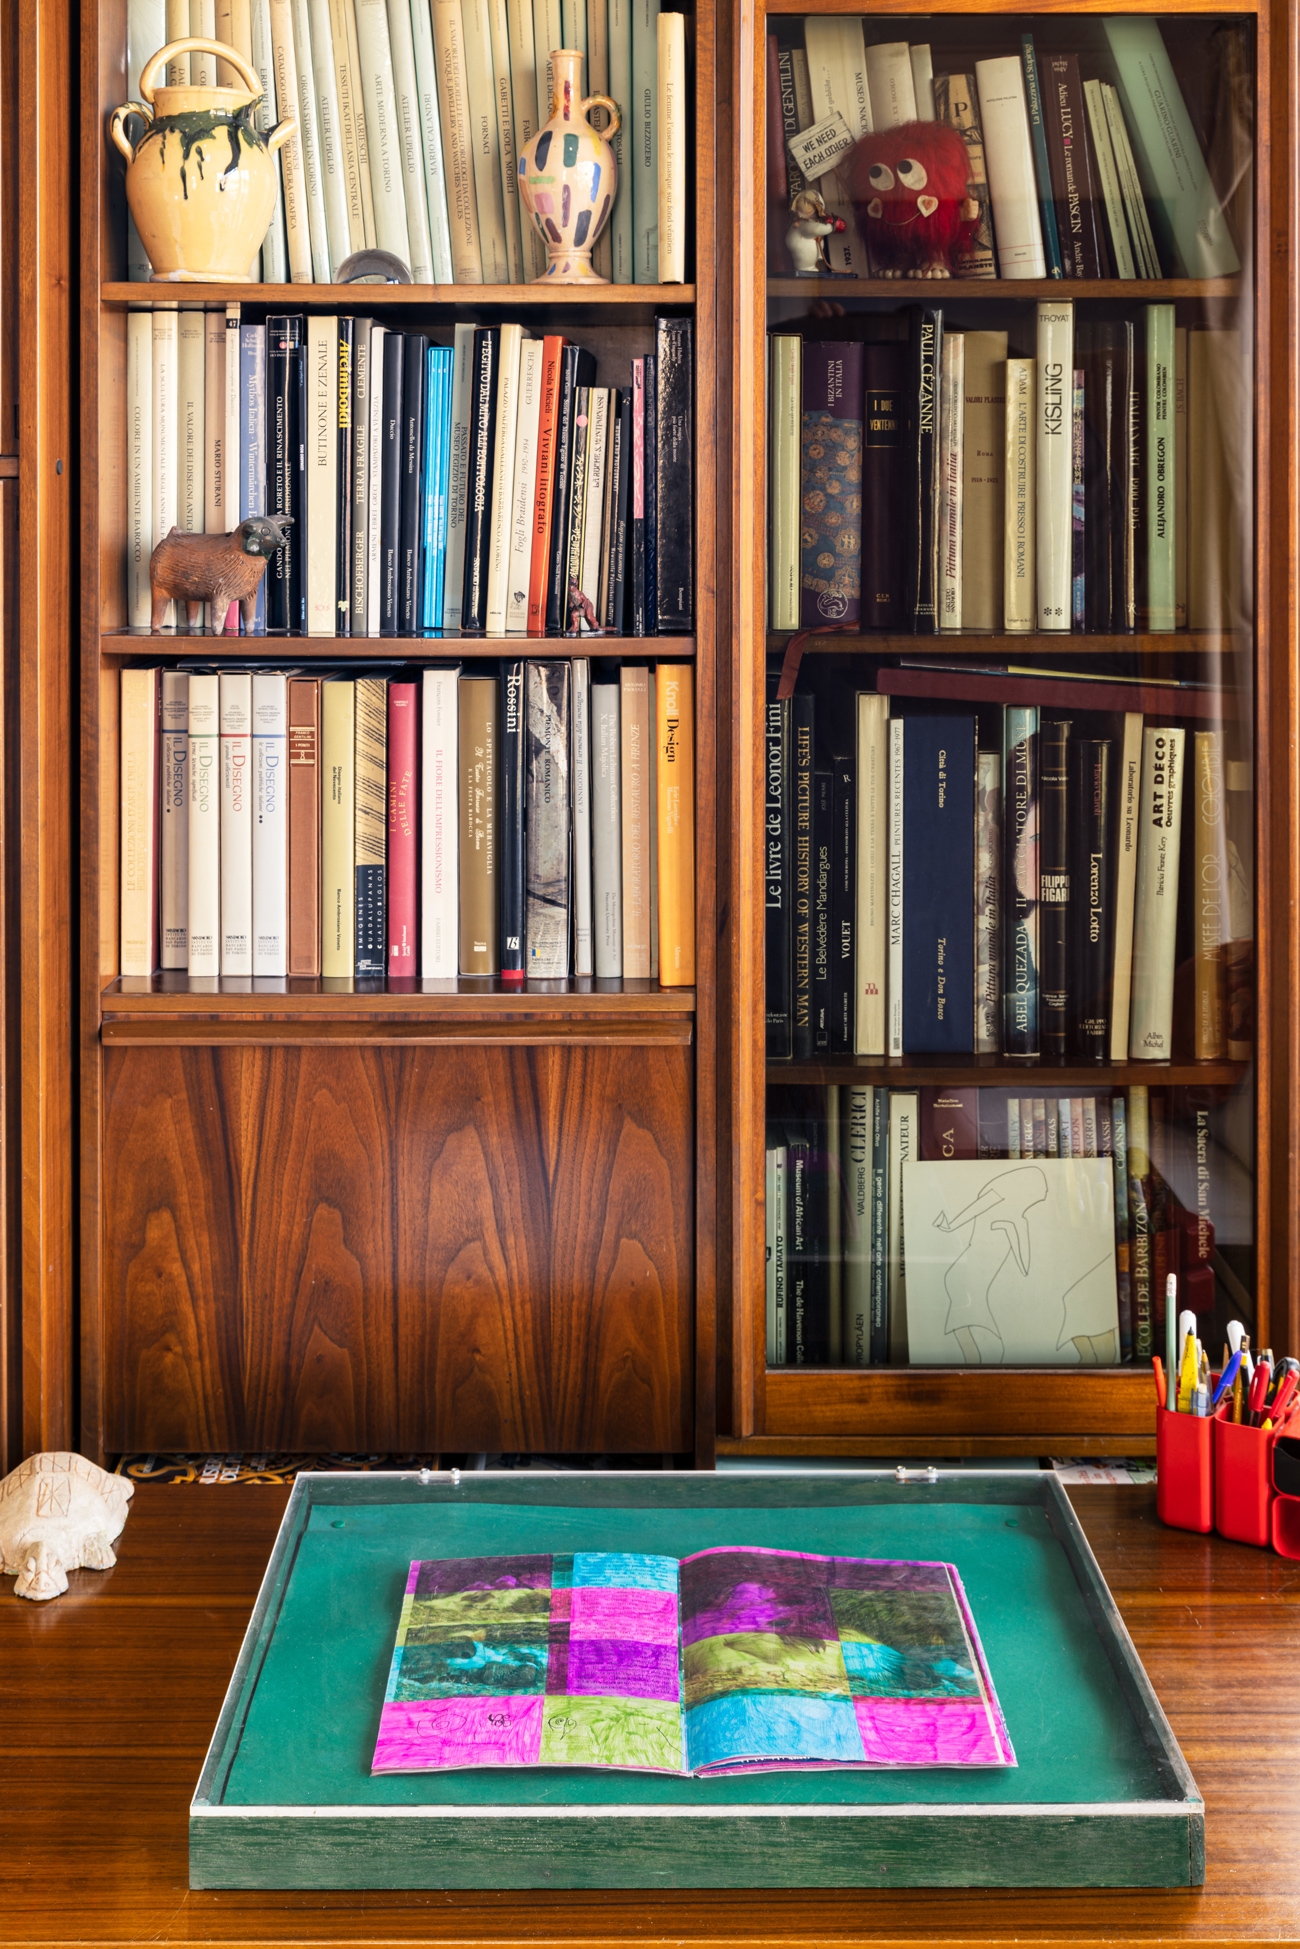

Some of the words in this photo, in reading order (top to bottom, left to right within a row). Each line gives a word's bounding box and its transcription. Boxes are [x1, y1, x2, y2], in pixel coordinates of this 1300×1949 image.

[1024, 44, 1035, 73] Stupinigi
[300, 75, 310, 110] ORGANI
[339, 64, 349, 99] TESSUTI
[374, 74, 385, 98] ARTE
[499, 78, 509, 118] GABETTI
[778, 51, 794, 115] GENTILINI
[854, 72, 865, 103] MUSEO
[1028, 82, 1039, 114] Palazzina
[1058, 83, 1068, 106] Adieu
[321, 95, 331, 134] ATELIER
[342, 102, 350, 122] IKAT
[377, 100, 388, 147] MODERNA
[402, 95, 412, 133] ATELIER
[424, 93, 436, 142] CALANDRI
[783, 117, 795, 130] DI
[1032, 116, 1040, 124] La
[1061, 108, 1073, 138] LUCY
[303, 113, 313, 150] STORICI
[344, 124, 355, 170] DELL'ASIA
[356, 113, 367, 164] MARIESCHI
[480, 116, 490, 155] FORNACI
[503, 128, 511, 156] ISOLA
[802, 138, 816, 153] WE
[816, 128, 836, 144] NEED
[307, 151, 314, 159] IN
[325, 136, 335, 174] UPIGLIO
[405, 135, 415, 173] UPIGLIO
[428, 143, 437, 176] MARIO
[803, 152, 825, 169] EACH
[825, 137, 850, 159] OTHER
[1064, 146, 1073, 156] Le
[307, 162, 317, 196] TORINO
[382, 157, 392, 192] TORINO
[505, 160, 514, 193] MOBILI
[348, 172, 359, 219] CENTRALE
[1069, 194, 1082, 232] PASCIN
[1074, 241, 1084, 263] André
[921, 324, 933, 359] PAUL
[318, 340, 328, 387] ZENALE
[357, 345, 366, 398] CLEMENTE
[481, 341, 492, 381] L'EGITTO
[545, 361, 555, 386] Nicola
[246, 375, 258, 405] Mythos
[339, 339, 351, 428] Arcimboldi
[480, 384, 489, 403] DAL
[544, 388, 553, 413] Micieli
[836, 388, 842, 397] IN
[921, 364, 935, 433] CÉZANNE
[1045, 363, 1062, 435] KISLING
[134, 406, 142, 442] COLORE
[249, 408, 257, 434] Italien
[318, 398, 328, 466] BUTINONE
[479, 404, 488, 427] MITO
[134, 445, 142, 455] IN
[134, 457, 142, 469] UN
[357, 425, 365, 467] FRAGILE
[540, 428, 552, 473] Viviani
[1157, 437, 1165, 481] OBREGON
[248, 442, 258, 508] Wintermärchen
[356, 470, 365, 504] TERRA
[475, 430, 487, 511] ALL'EGITTOLOGIA
[134, 472, 142, 517] AMBIENTE
[536, 478, 549, 534] litografo
[1157, 486, 1166, 538] ALEJANDRO
[134, 519, 142, 562] BAROCCO
[355, 531, 364, 613] BISCHOFBERGER
[506, 675, 521, 733] Rossini
[666, 681, 679, 716] Knoll
[435, 750, 443, 759] IL
[663, 718, 679, 762] Design
[798, 727, 810, 766] LIFE'S
[1016, 724, 1027, 764] MUSE
[435, 761, 443, 784] FIORE
[766, 743, 782, 809] Leonor
[938, 750, 947, 769] Città
[1016, 769, 1027, 785] DI
[1152, 737, 1165, 785] DÉCO
[1166, 738, 1176, 789] graphiques
[399, 771, 413, 796] FATE
[798, 772, 810, 830] PICTURE
[938, 782, 947, 808] Torino
[399, 801, 412, 837] DELLE
[766, 814, 782, 835] de
[1152, 791, 1165, 827] ART
[1165, 791, 1174, 827] Oeuvres
[435, 787, 443, 893] DELL'IMPRESSIONISMO
[1016, 792, 1027, 889] CACCIATORE
[766, 841, 782, 880] livre
[797, 836, 810, 895] HISTORY
[816, 846, 829, 910] Mandiargues
[1090, 853, 1102, 904] Lorenzo
[891, 851, 901, 907] CHAGALL
[1041, 875, 1070, 887] FILIPPO
[1041, 888, 1070, 902] FIGARI
[797, 899, 809, 918] OF
[1090, 907, 1101, 942] Lotto
[816, 913, 827, 964] Belvédère
[841, 921, 850, 958] VOUET
[891, 910, 901, 945] MARC
[797, 923, 809, 989] WESTERN
[937, 938, 945, 966] Torino
[1015, 925, 1029, 994] QUEZADA
[816, 967, 827, 980] Le
[937, 977, 945, 994] Don
[797, 994, 809, 1027] MAN
[937, 997, 945, 1020] Bosco
[1015, 999, 1027, 1032] ABEL
[850, 1092, 866, 1163] CLERICI
[1048, 1118, 1056, 1152] DEGAS
[1196, 1111, 1208, 1126] La
[1197, 1129, 1208, 1164] Sacra
[1197, 1166, 1209, 1179] di
[857, 1167, 865, 1216] WALDBERG
[1198, 1182, 1209, 1205] San
[1135, 1201, 1149, 1277] BARBIZON
[1198, 1210, 1210, 1259] Michele
[776, 1276, 784, 1308] RUFINO
[1137, 1282, 1149, 1302] DE
[1137, 1308, 1151, 1356] ECOLE
